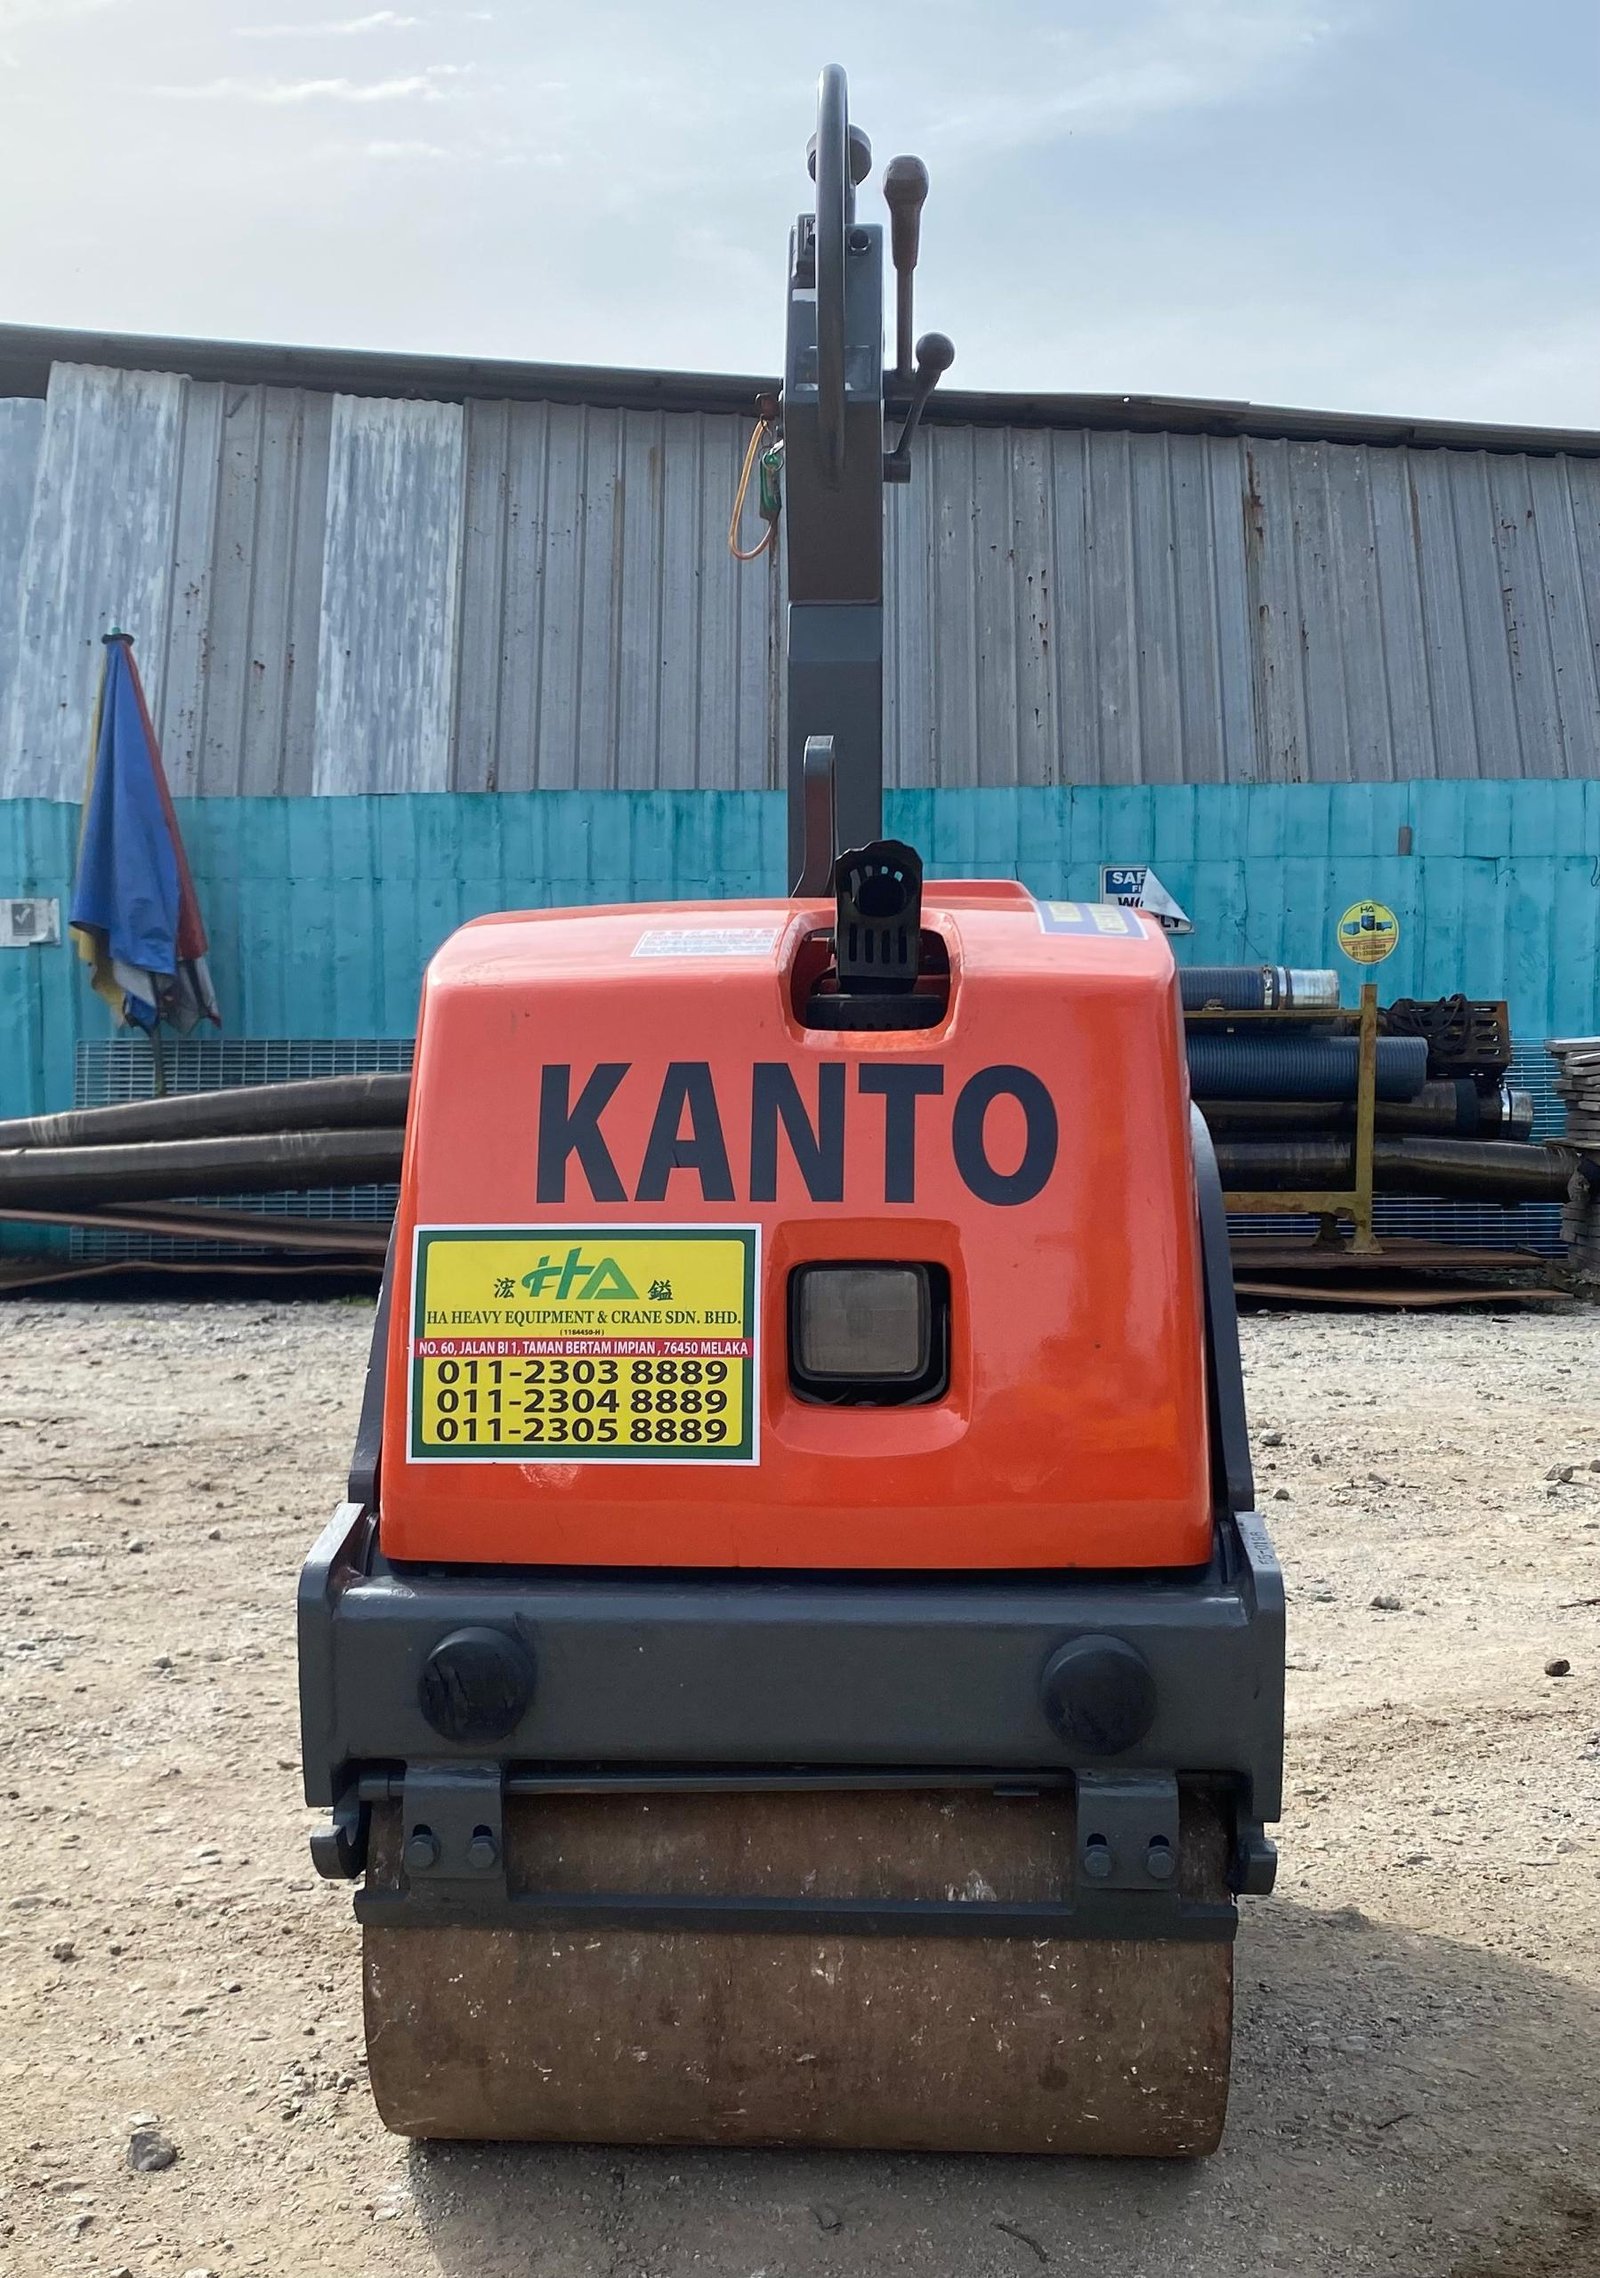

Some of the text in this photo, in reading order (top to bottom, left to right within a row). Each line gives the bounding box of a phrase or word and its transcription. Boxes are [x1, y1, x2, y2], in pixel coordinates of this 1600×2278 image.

[1112, 871, 1147, 885] SAF
[536, 1061, 1059, 1207] KANTO
[521, 1246, 641, 1300] HA
[426, 1310, 742, 1327] HA HEAVY EQUIPMENT & CRANE SDN. BHD.
[418, 1341, 439, 1355] NO.
[440, 1341, 458, 1356] 60,
[459, 1341, 496, 1355] JALAN
[499, 1341, 509, 1355] BI
[511, 1341, 521, 1356] 1,
[522, 1341, 564, 1355] TAMAN
[566, 1341, 612, 1355] BERTAM
[663, 1341, 699, 1355] 76450
[700, 1341, 748, 1355] MELAKA
[437, 1360, 728, 1385] 011-2303 8889
[436, 1389, 728, 1414] 011-2304 8889
[436, 1417, 728, 1442] 011-2305 8889
